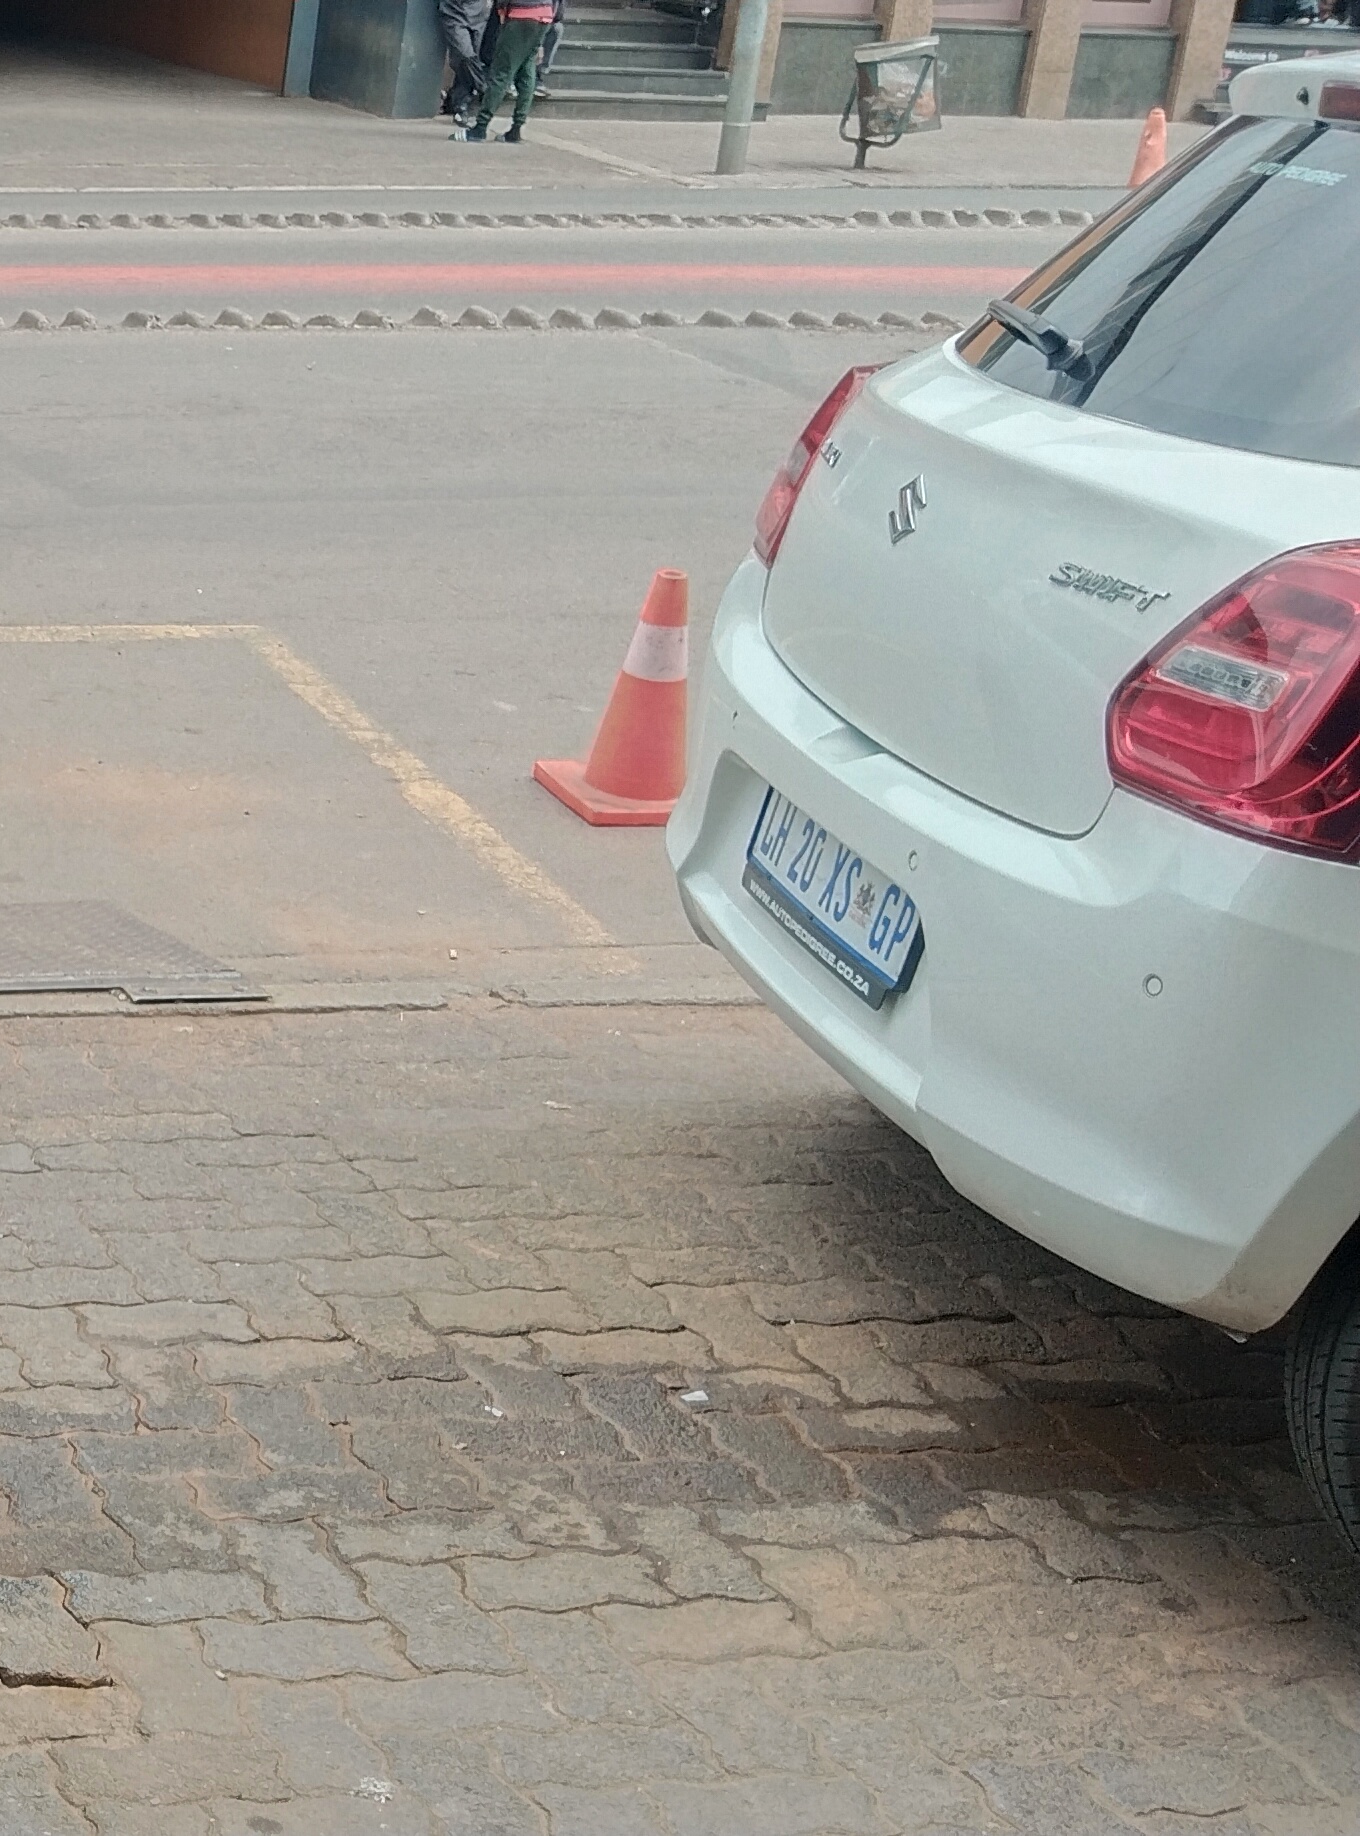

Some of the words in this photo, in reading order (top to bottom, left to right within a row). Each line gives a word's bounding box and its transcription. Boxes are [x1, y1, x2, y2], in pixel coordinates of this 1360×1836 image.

[1048, 562, 1171, 613] SWIFT
[786, 817, 828, 893] 20
[818, 842, 863, 923] XS
[868, 883, 916, 962] GP
